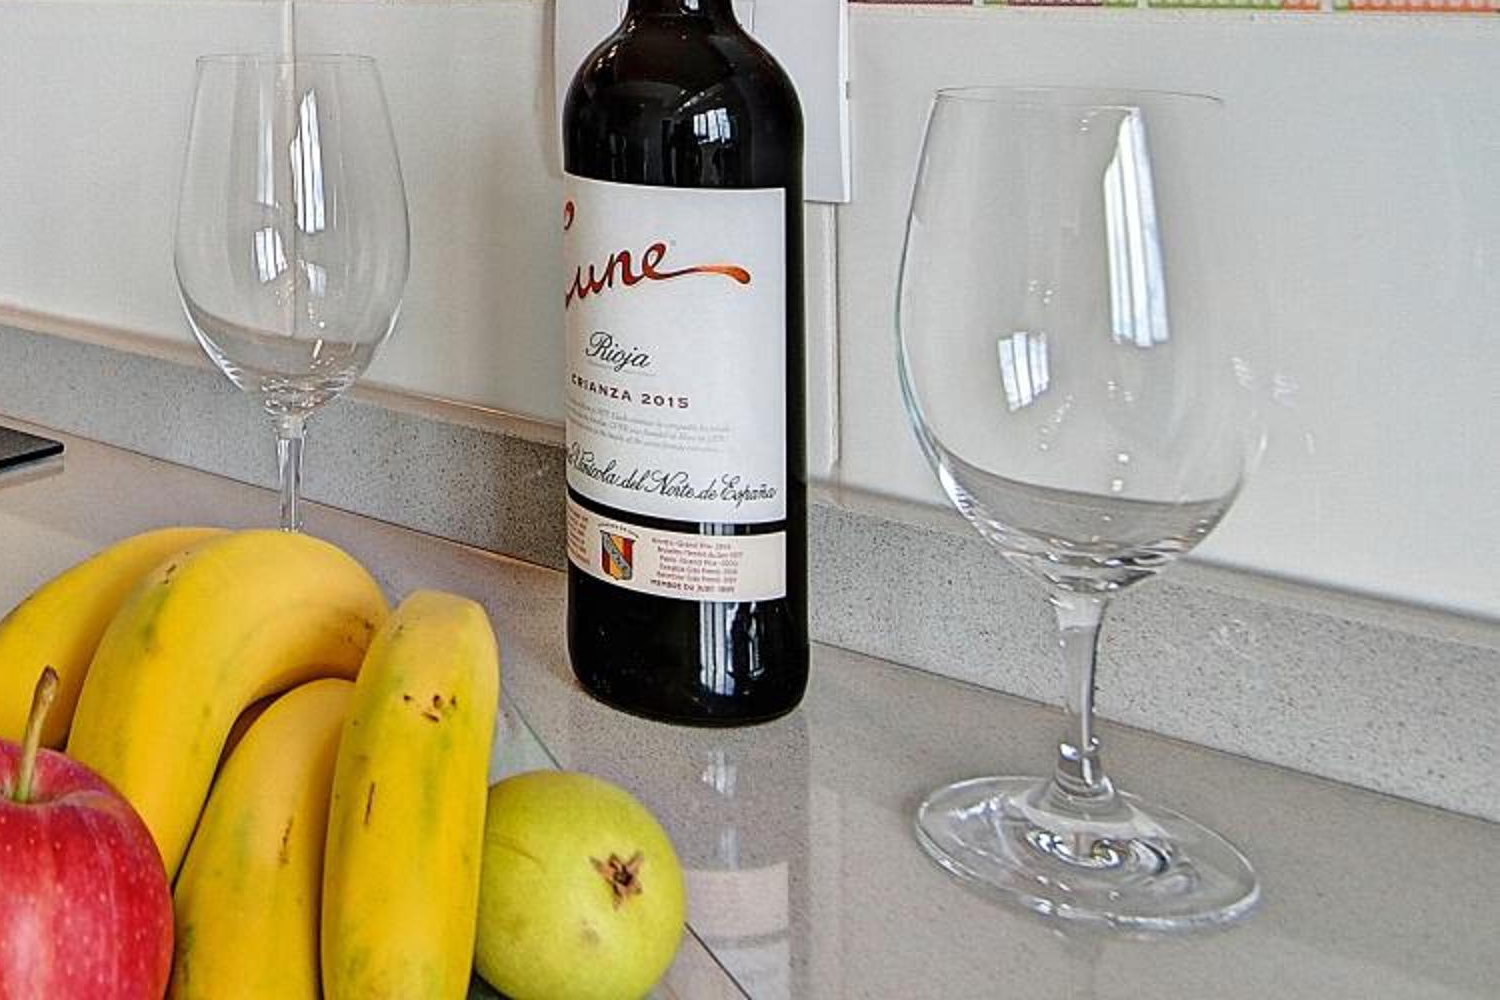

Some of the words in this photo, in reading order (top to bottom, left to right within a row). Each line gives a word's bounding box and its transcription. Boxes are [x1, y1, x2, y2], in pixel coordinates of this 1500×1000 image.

[585, 331, 651, 372] Rioja
[571, 373, 632, 402] CRIANZA
[641, 393, 689, 409] 2015
[619, 468, 650, 491] del
[644, 470, 695, 497] Norte
[696, 478, 718, 500] de
[719, 473, 777, 508] España
